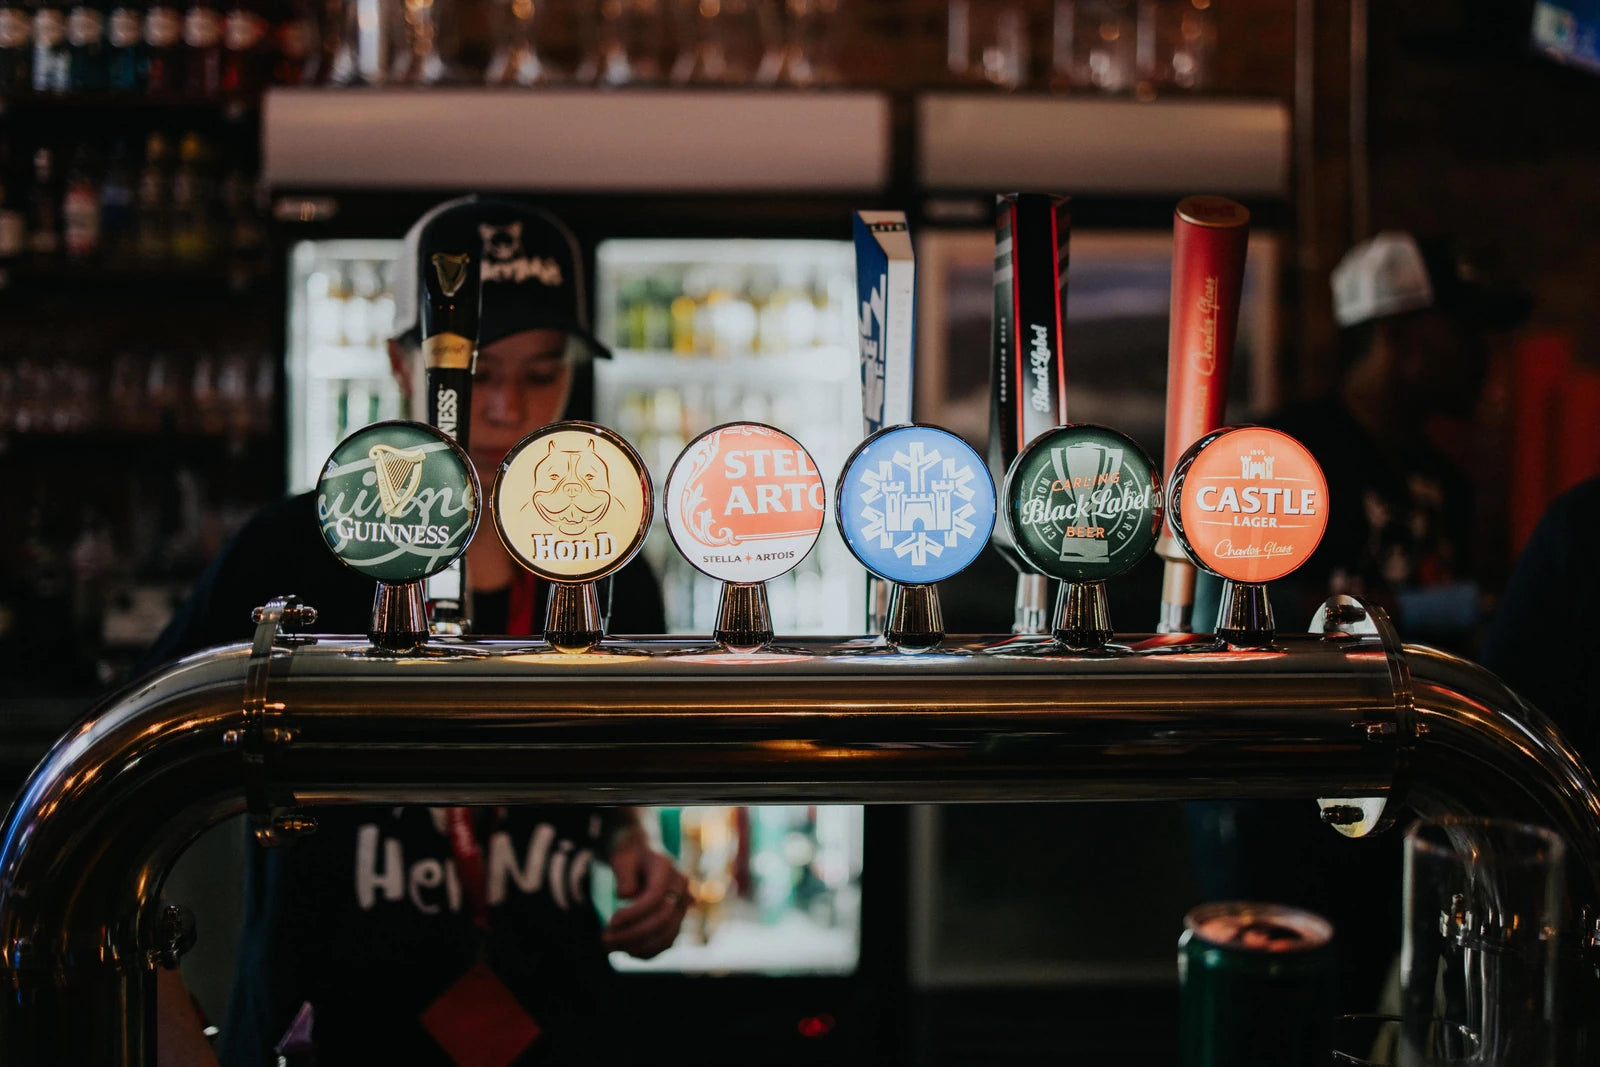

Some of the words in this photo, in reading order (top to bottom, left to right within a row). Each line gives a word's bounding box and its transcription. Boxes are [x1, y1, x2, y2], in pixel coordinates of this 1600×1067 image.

[1030, 324, 1051, 366] Label
[1031, 366, 1051, 413] Black
[1051, 472, 1121, 492] CARLING
[1021, 494, 1090, 525] Black
[1090, 484, 1150, 519] Label
[1196, 486, 1316, 515] CASTLE
[336, 517, 450, 544] GUINNESS
[1066, 526, 1105, 539] BEER
[1233, 516, 1278, 528] LAGER
[703, 555, 742, 563] STELLA
[756, 551, 795, 561] ARTOIS
[1214, 539, 1262, 557] Charles
[1263, 541, 1293, 559] Glass
